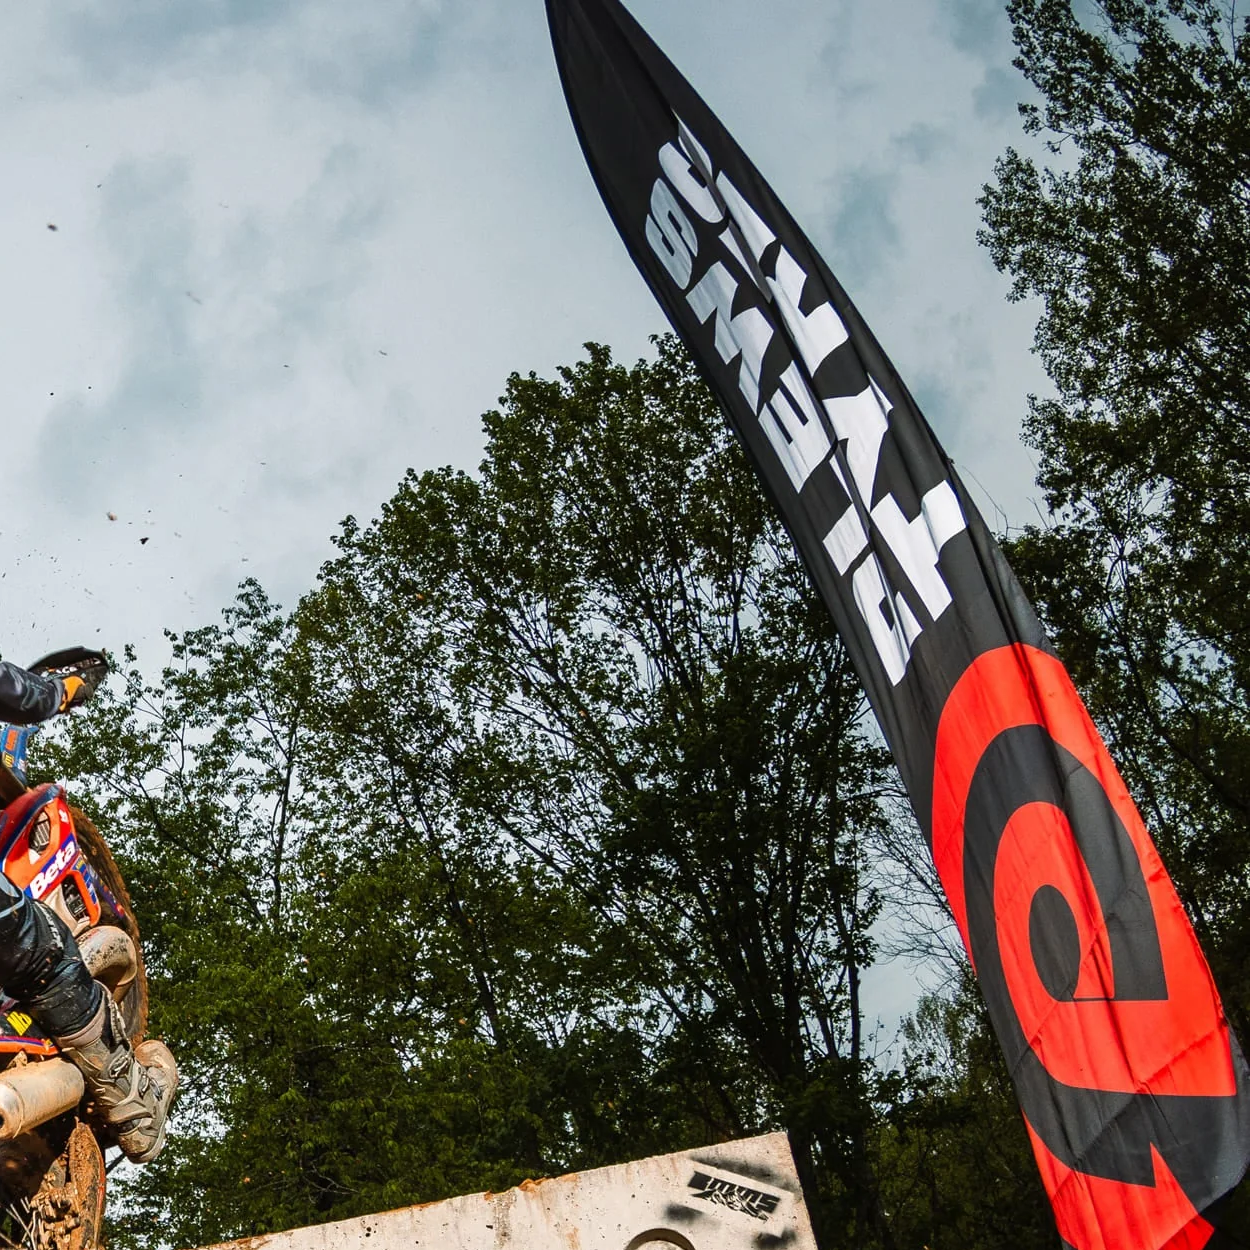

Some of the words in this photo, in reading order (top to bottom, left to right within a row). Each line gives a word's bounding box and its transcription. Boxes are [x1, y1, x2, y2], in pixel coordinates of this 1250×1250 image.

[645, 177, 923, 686] PLEWS
[658, 110, 966, 622] TYRES
[29, 841, 76, 900] Beta
